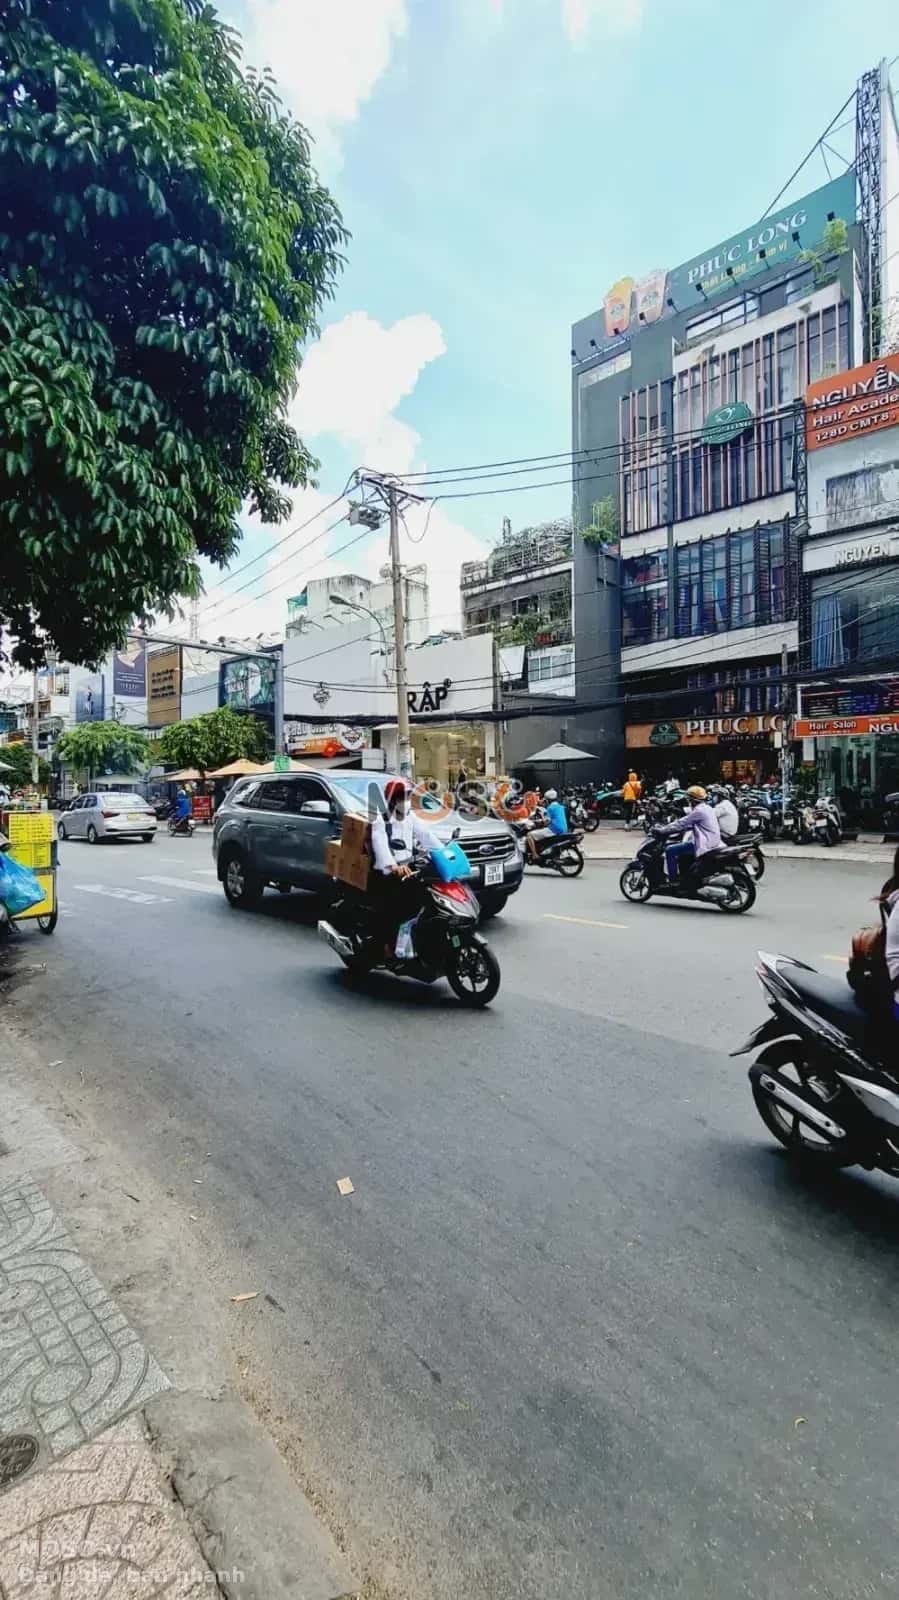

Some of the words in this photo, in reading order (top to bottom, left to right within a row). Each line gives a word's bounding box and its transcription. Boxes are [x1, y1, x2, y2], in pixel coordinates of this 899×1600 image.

[746, 209, 808, 253] LONG
[812, 364, 899, 410] NGUYỄN
[813, 411, 845, 427] Hair
[849, 411, 889, 430] CMT8
[809, 721, 829, 731] Hair
[832, 719, 857, 730] Salon
